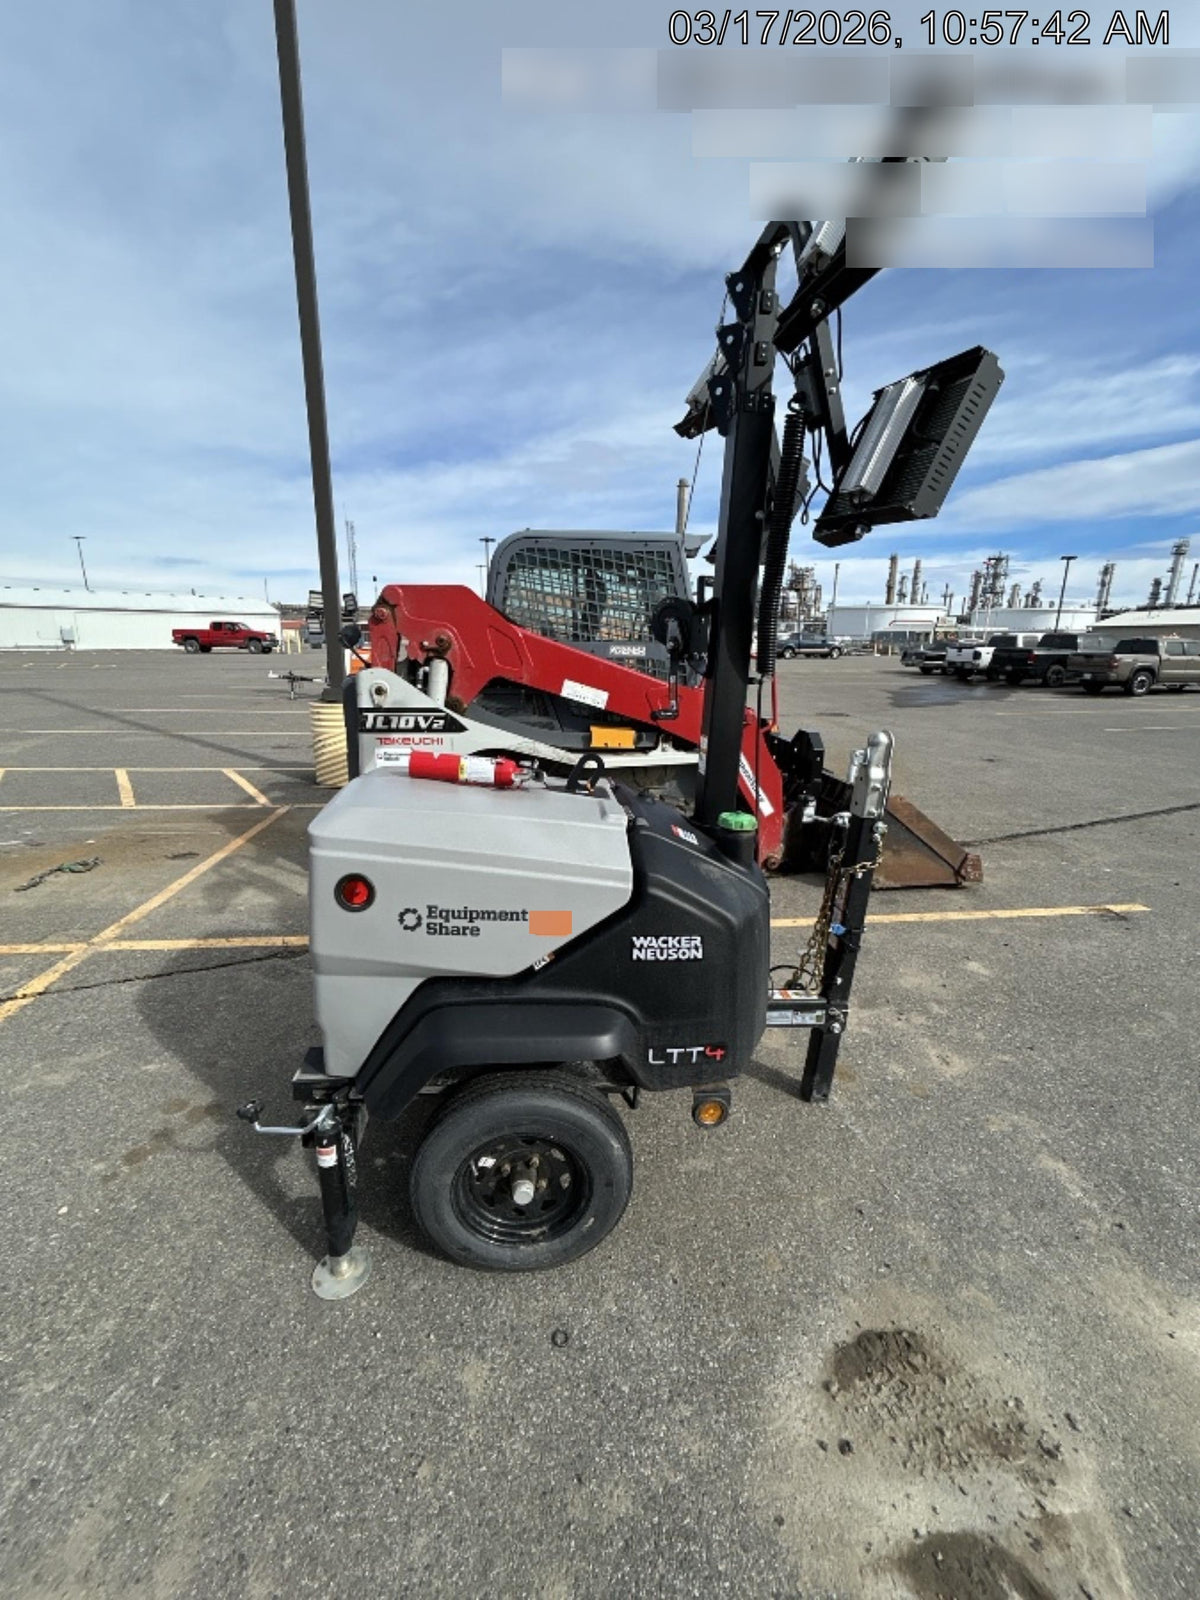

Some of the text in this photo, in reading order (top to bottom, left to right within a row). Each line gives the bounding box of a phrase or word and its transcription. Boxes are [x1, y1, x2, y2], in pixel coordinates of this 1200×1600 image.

[426, 904, 529, 923] Equipment
[426, 922, 481, 937] Share
[631, 936, 702, 948] WACKER
[632, 947, 703, 960] NEUSON
[648, 1046, 725, 1065] LTT4
